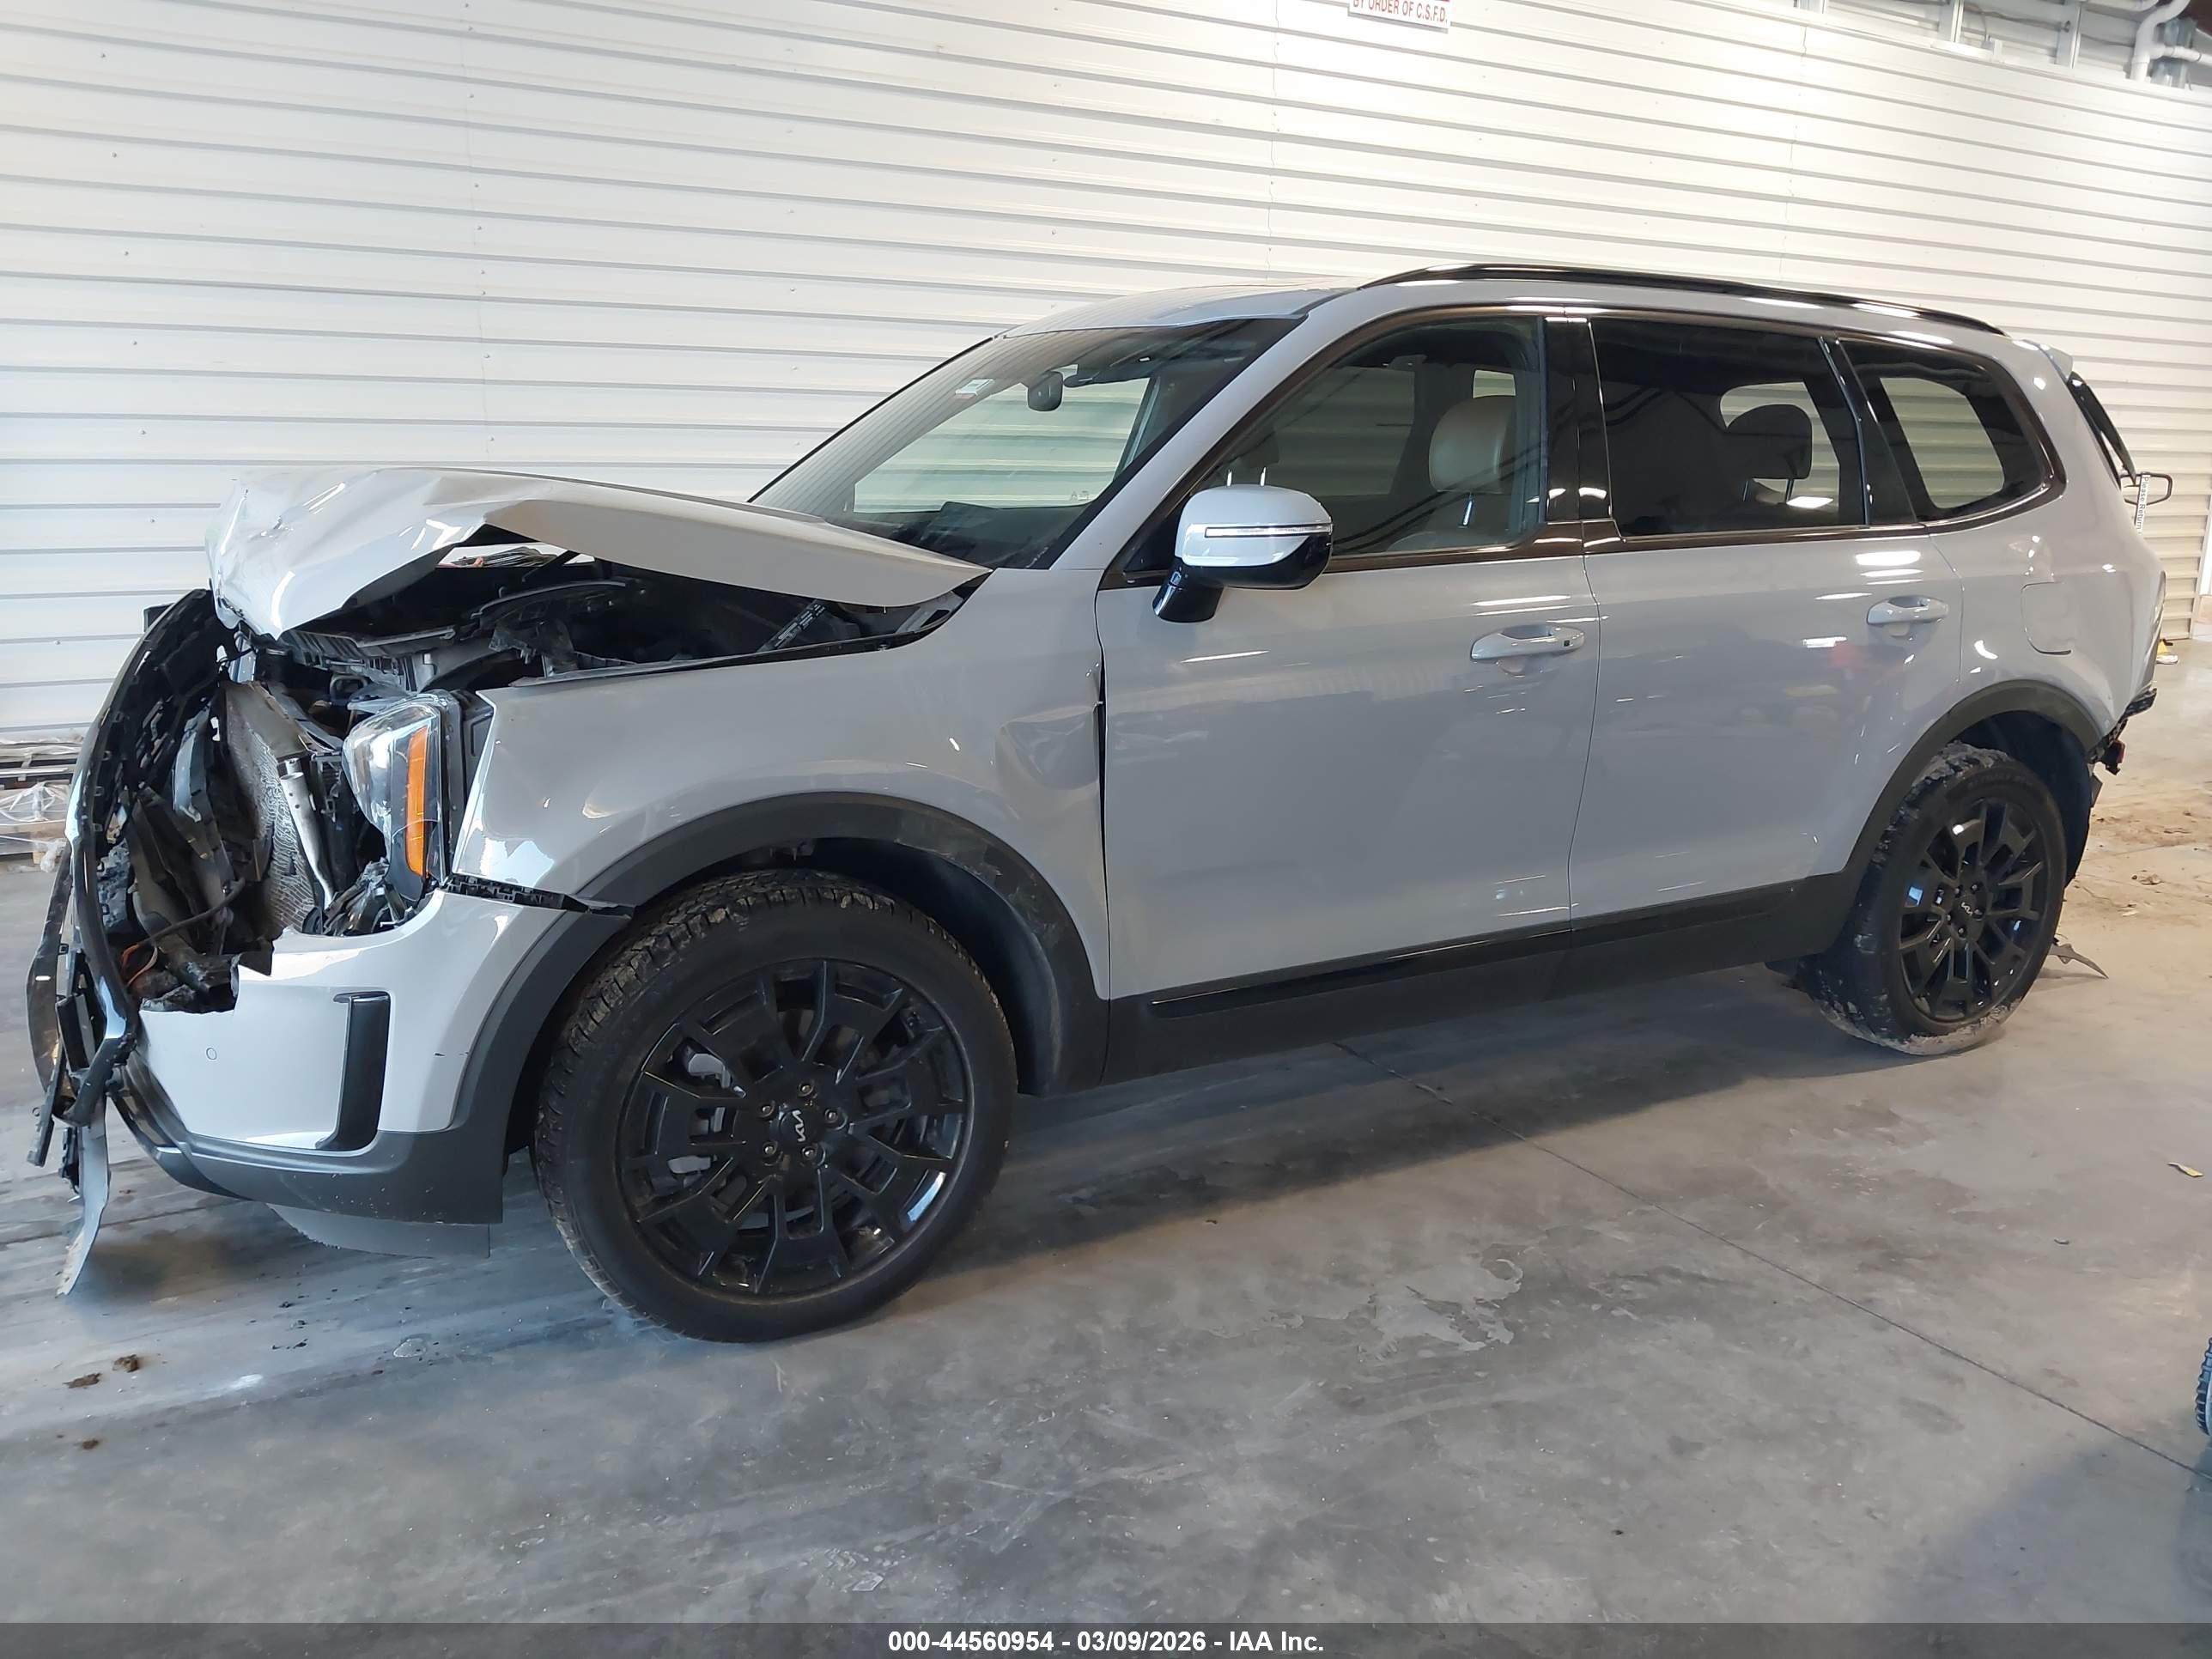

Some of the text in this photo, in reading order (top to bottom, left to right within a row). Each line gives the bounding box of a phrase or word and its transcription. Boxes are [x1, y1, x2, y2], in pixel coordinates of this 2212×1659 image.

[1368, 0, 1400, 14] ORDER
[1402, 1, 1414, 16] OF
[1416, 3, 1449, 23] C.S.F.D.
[2141, 477, 2149, 501] Please
